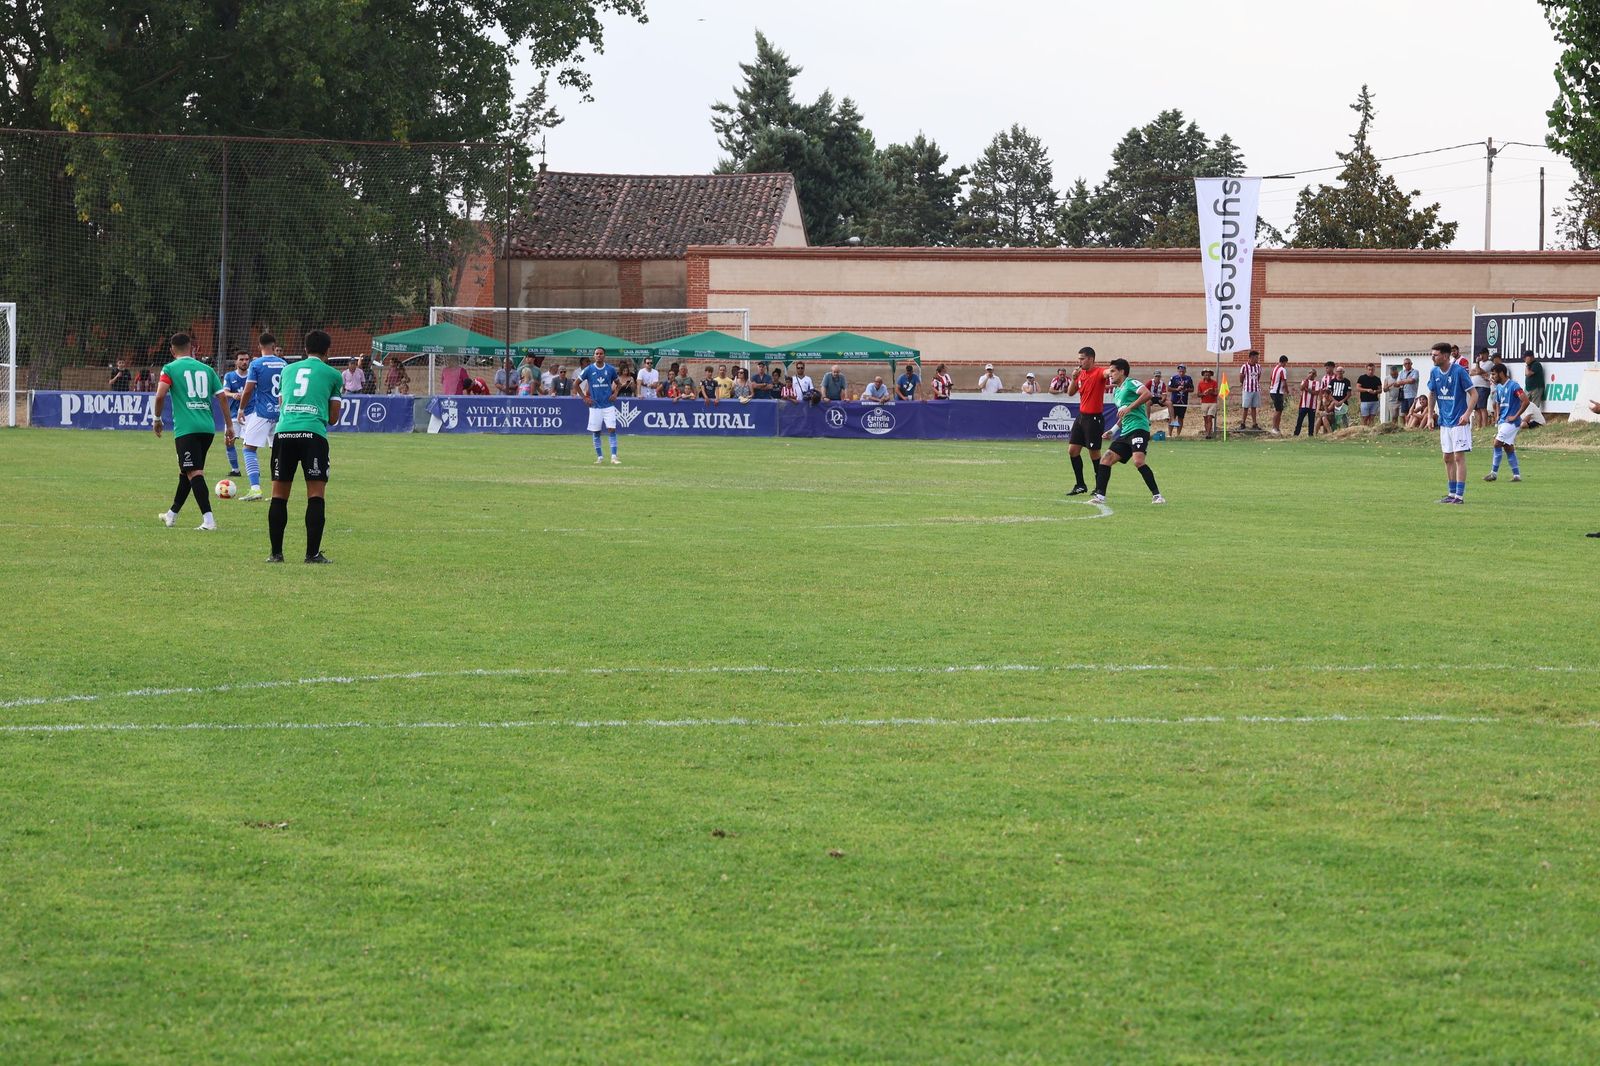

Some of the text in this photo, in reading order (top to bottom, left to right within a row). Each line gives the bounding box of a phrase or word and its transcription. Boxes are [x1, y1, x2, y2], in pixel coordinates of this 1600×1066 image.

[1213, 180, 1241, 351] synergias
[1501, 316, 1568, 359] IMPULSO27
[184, 370, 208, 398] 10
[272, 374, 281, 398] 8
[294, 368, 312, 397] 5
[60, 394, 164, 426] PROCARZA
[118, 415, 138, 426] S.L.
[466, 406, 561, 415] AYUNTAMIENTO DE
[466, 416, 562, 428] VILLARALBO
[643, 412, 756, 429] CAJA RURAL
[1042, 422, 1070, 430] Revilla
